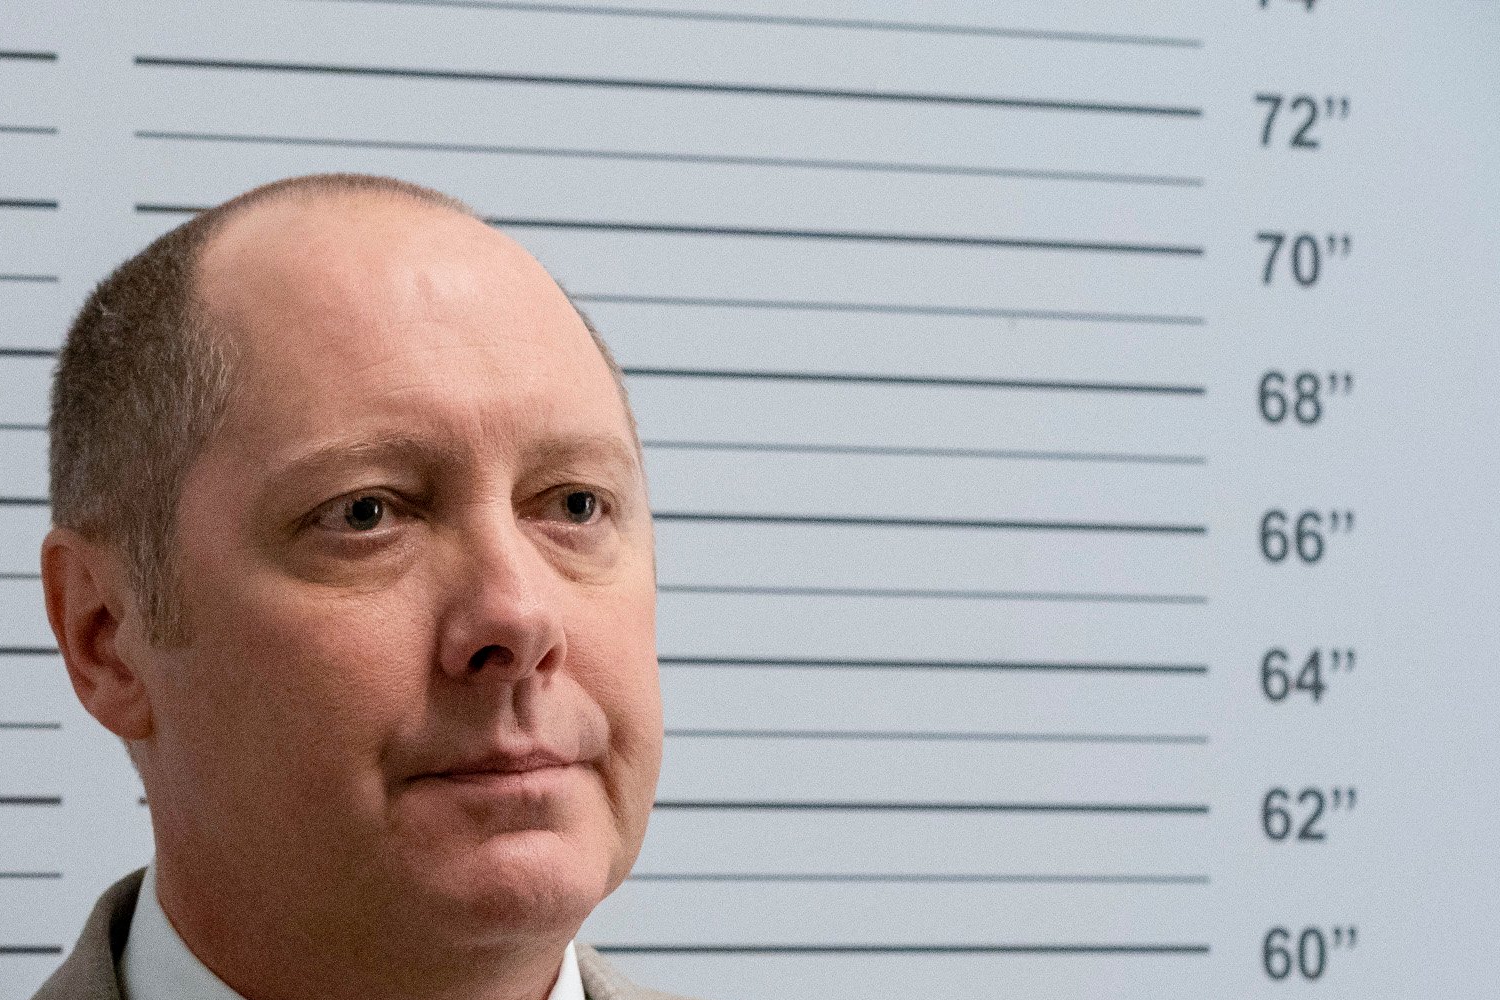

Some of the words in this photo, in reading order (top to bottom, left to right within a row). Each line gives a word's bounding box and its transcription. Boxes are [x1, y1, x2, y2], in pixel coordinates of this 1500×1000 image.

[1252, 92, 1351, 152] 72”
[1254, 230, 1352, 290] 70”
[1256, 368, 1354, 428] 68”
[1257, 507, 1356, 567] 66”
[1258, 646, 1357, 705] 64”
[1259, 786, 1358, 844] 62”
[1260, 924, 1359, 983] 60”
